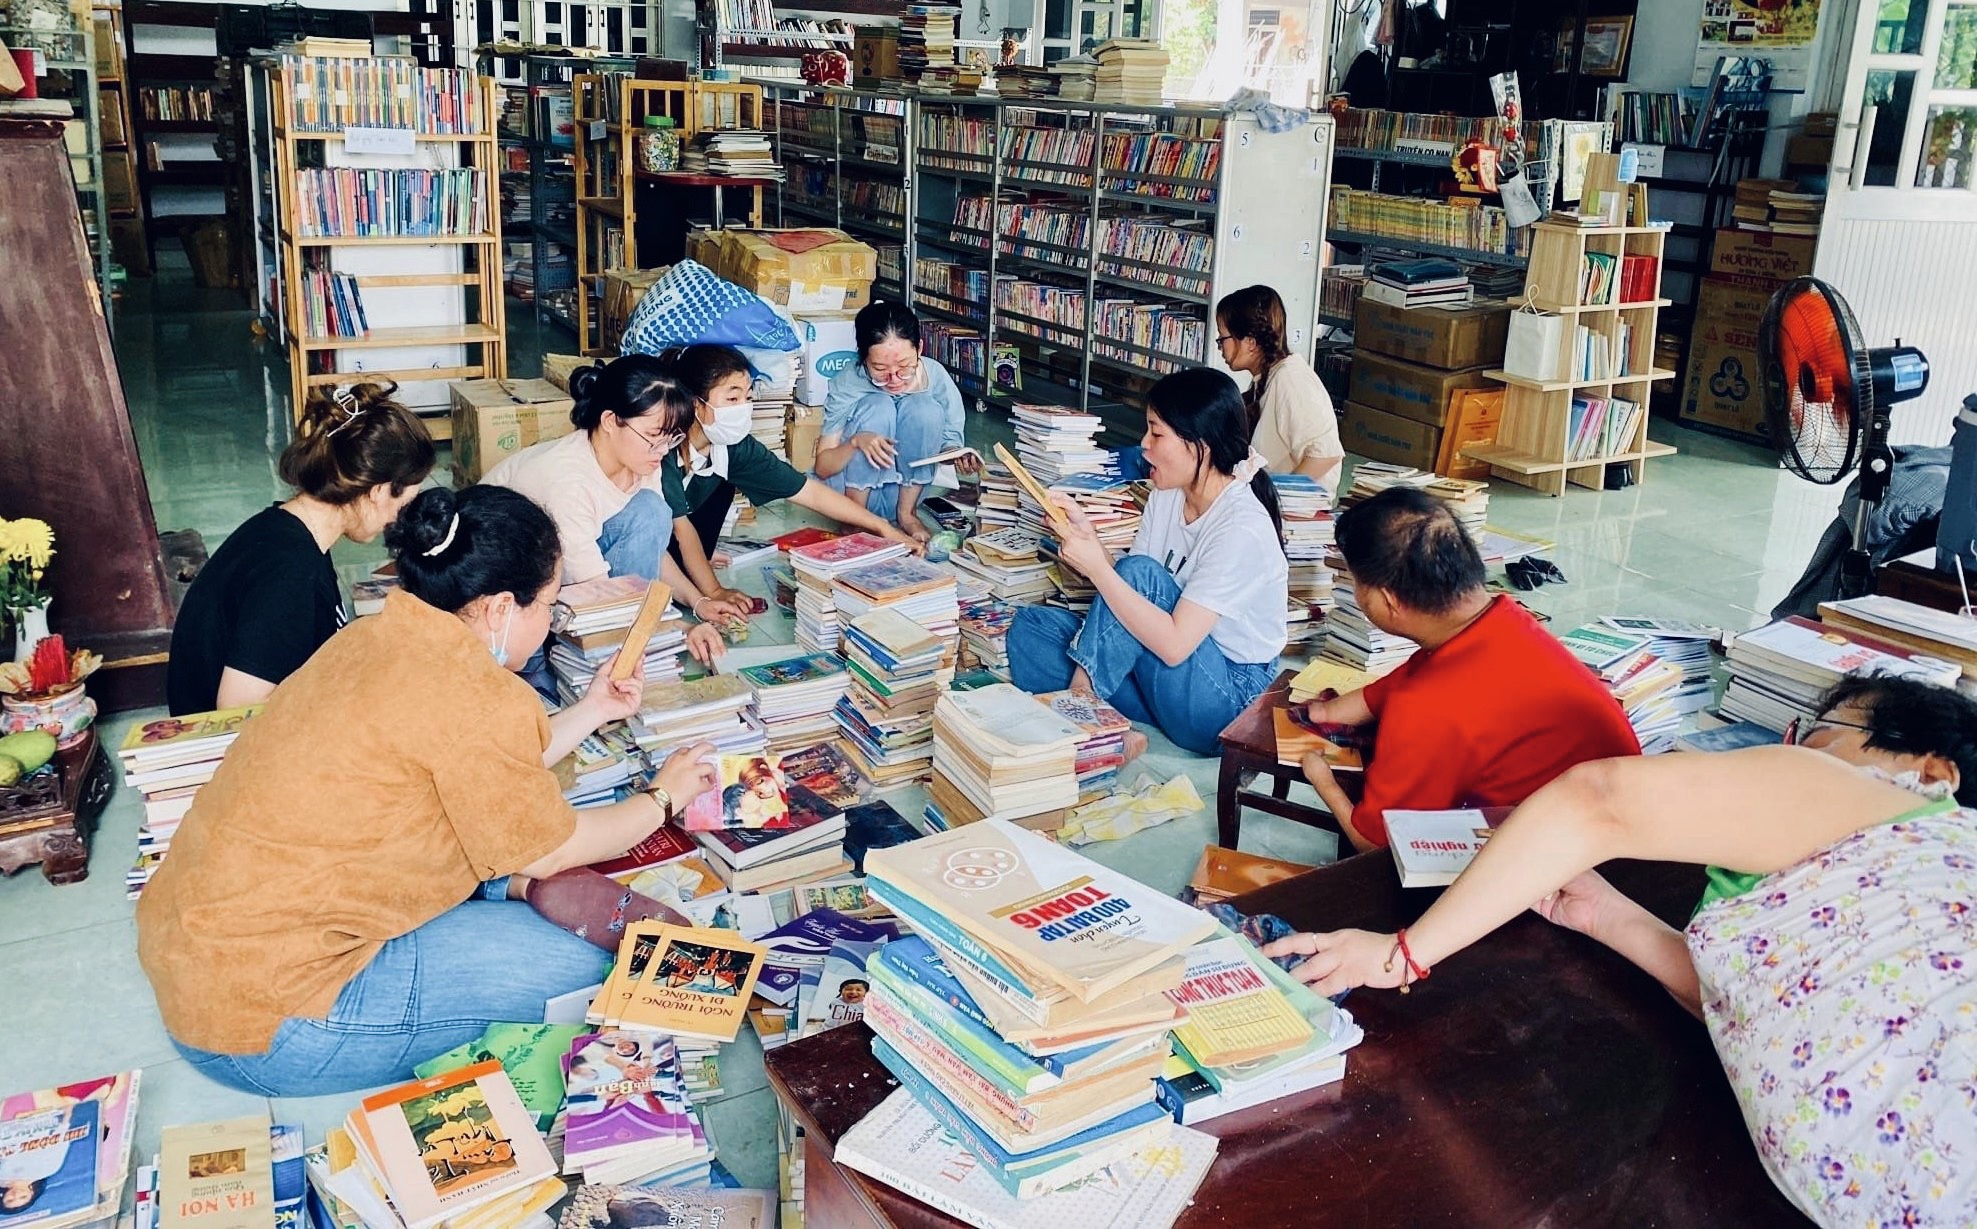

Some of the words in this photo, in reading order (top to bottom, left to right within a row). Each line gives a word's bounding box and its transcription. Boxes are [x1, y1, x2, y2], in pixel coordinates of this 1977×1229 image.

[1241, 132, 1249, 146] 5
[1313, 157, 1318, 171] 1
[904, 179, 911, 190] 2
[1233, 226, 1241, 239] 6
[1303, 242, 1310, 255] 2
[1294, 330, 1301, 344] 3
[355, 361, 362, 372] 3
[1091, 898, 1132, 918] 400
[1009, 912, 1042, 929] 6
[695, 1005, 734, 1018] NGÔI
